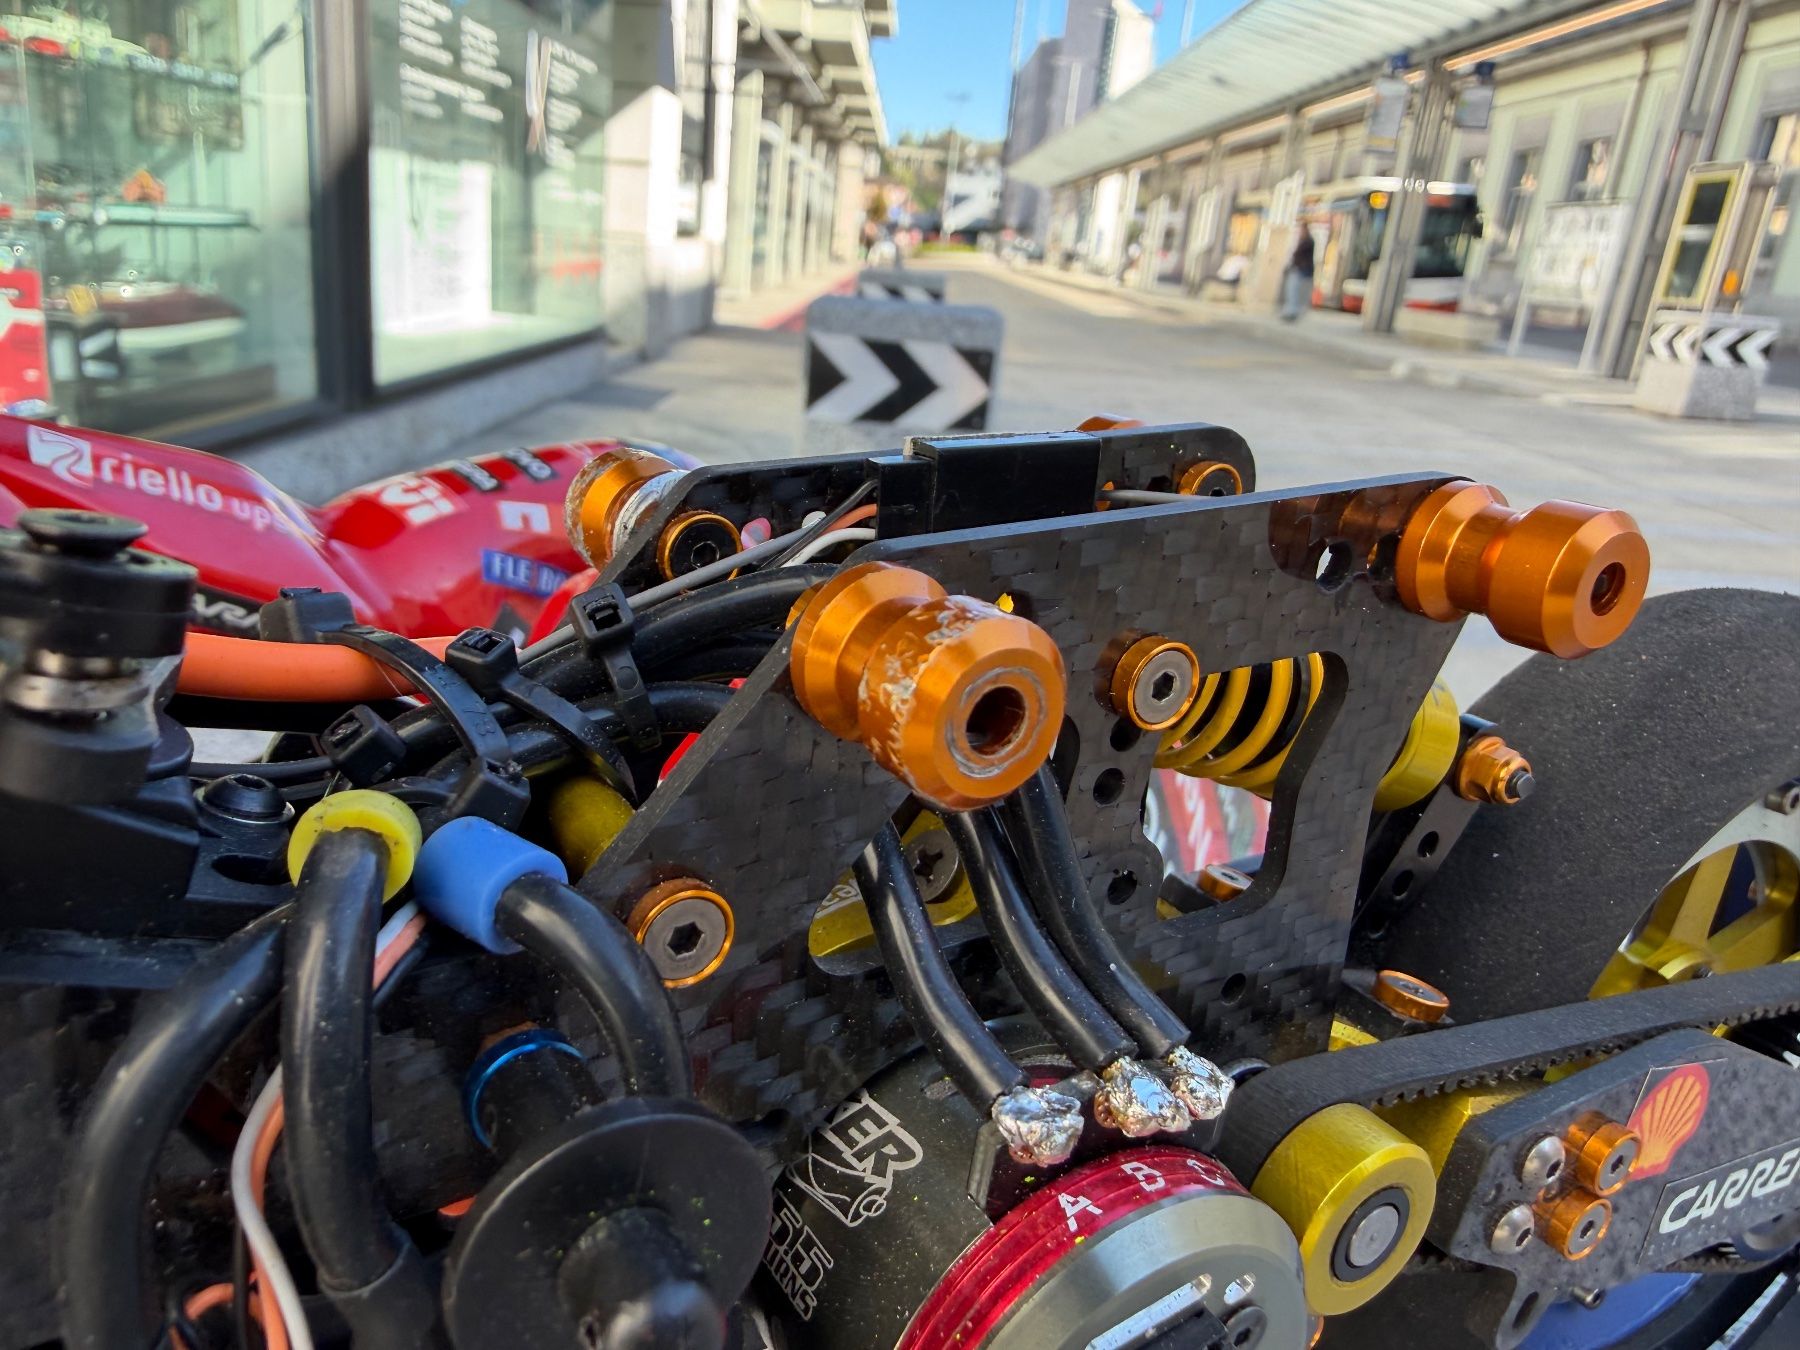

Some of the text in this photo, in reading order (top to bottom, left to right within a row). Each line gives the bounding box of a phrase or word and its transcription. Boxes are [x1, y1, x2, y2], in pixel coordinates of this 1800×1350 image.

[102, 452, 222, 512] riello
[1058, 1158, 1225, 1232] A B C
